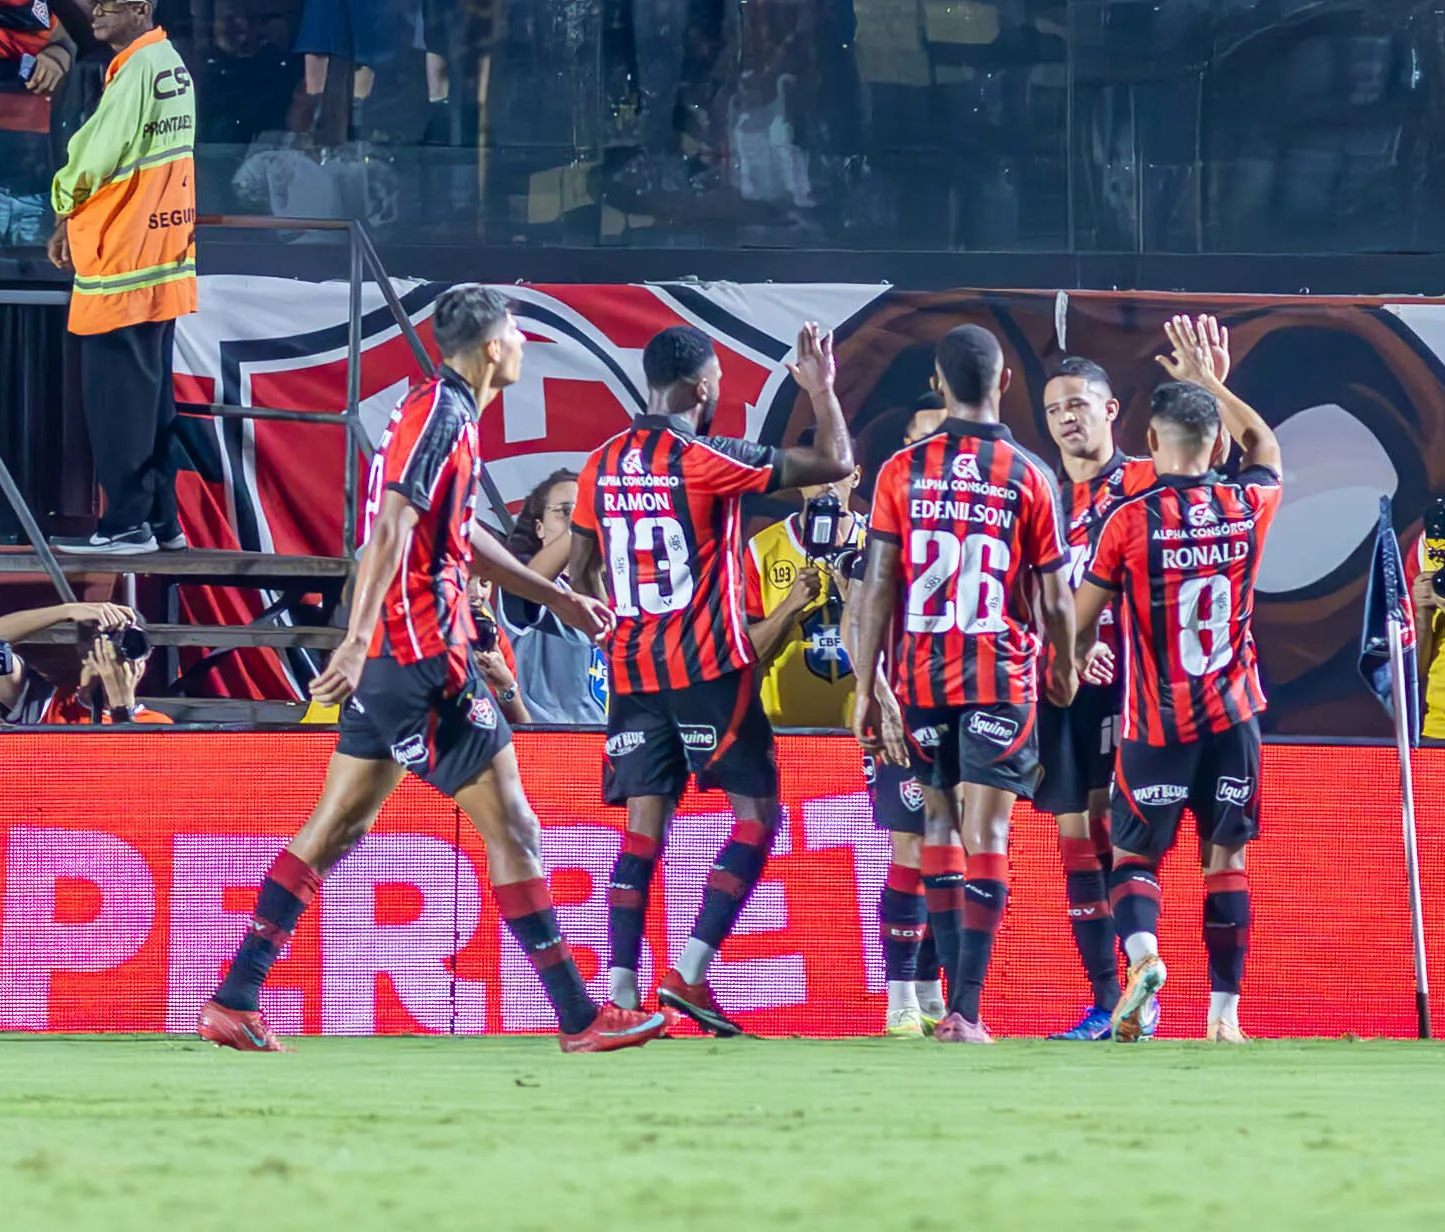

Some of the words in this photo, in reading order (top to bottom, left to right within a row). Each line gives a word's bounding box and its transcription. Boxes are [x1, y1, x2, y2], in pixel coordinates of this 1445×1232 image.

[622, 473, 679, 488] CONSÓRCIO
[913, 478, 949, 491] ALPHA
[951, 479, 1017, 501] CONSÓRCIO
[603, 492, 671, 512] RAMON
[910, 498, 1013, 529] EDENILSON
[1152, 528, 1188, 541] ALPHA
[1190, 518, 1255, 538] CONSÓRCIO
[602, 516, 694, 617] 13
[1162, 540, 1249, 569] RONALD
[906, 528, 1011, 635] 26
[1178, 574, 1234, 677] 8
[818, 637, 842, 648] CBF
[971, 714, 1013, 740] Iquine
